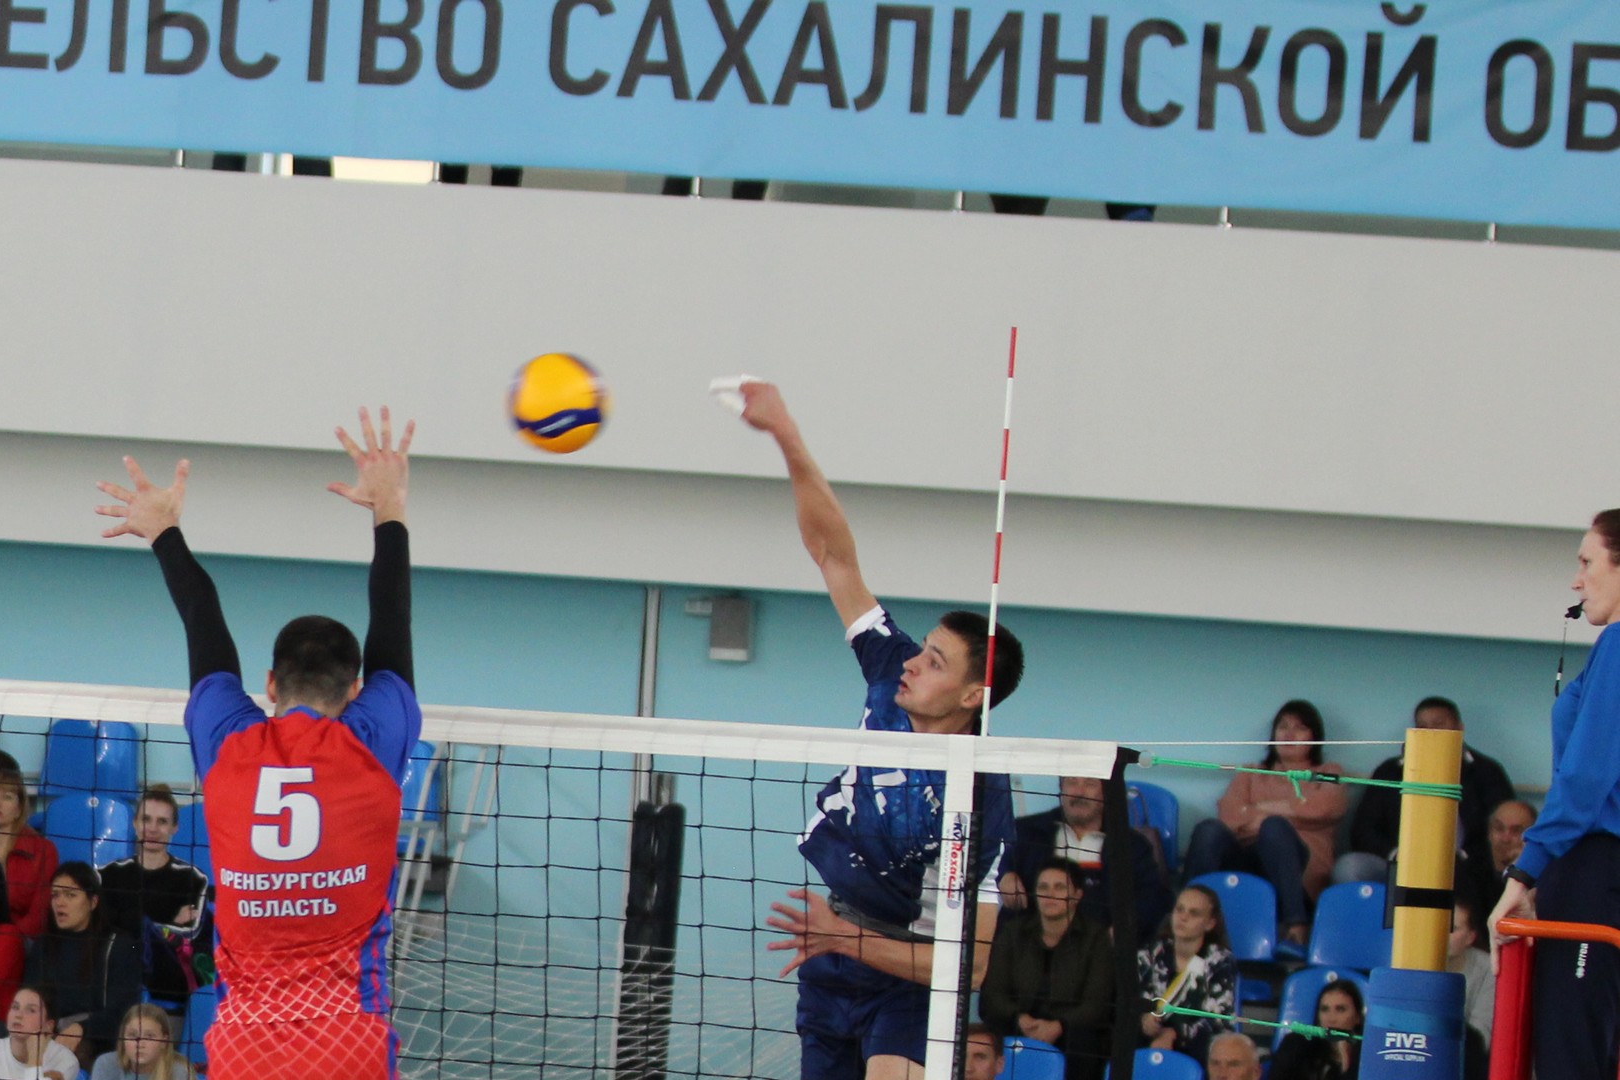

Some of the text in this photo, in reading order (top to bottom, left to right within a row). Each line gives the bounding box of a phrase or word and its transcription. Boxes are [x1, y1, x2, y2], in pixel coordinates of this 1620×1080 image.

[548, 0, 1438, 144] САХАЛИНСКОЙ
[251, 766, 321, 862] 5
[220, 864, 367, 891] ОРЕНБУРГСКАЯ
[238, 898, 337, 918] ОБЛАСТЬ
[1385, 1032, 1427, 1049] FIVB
